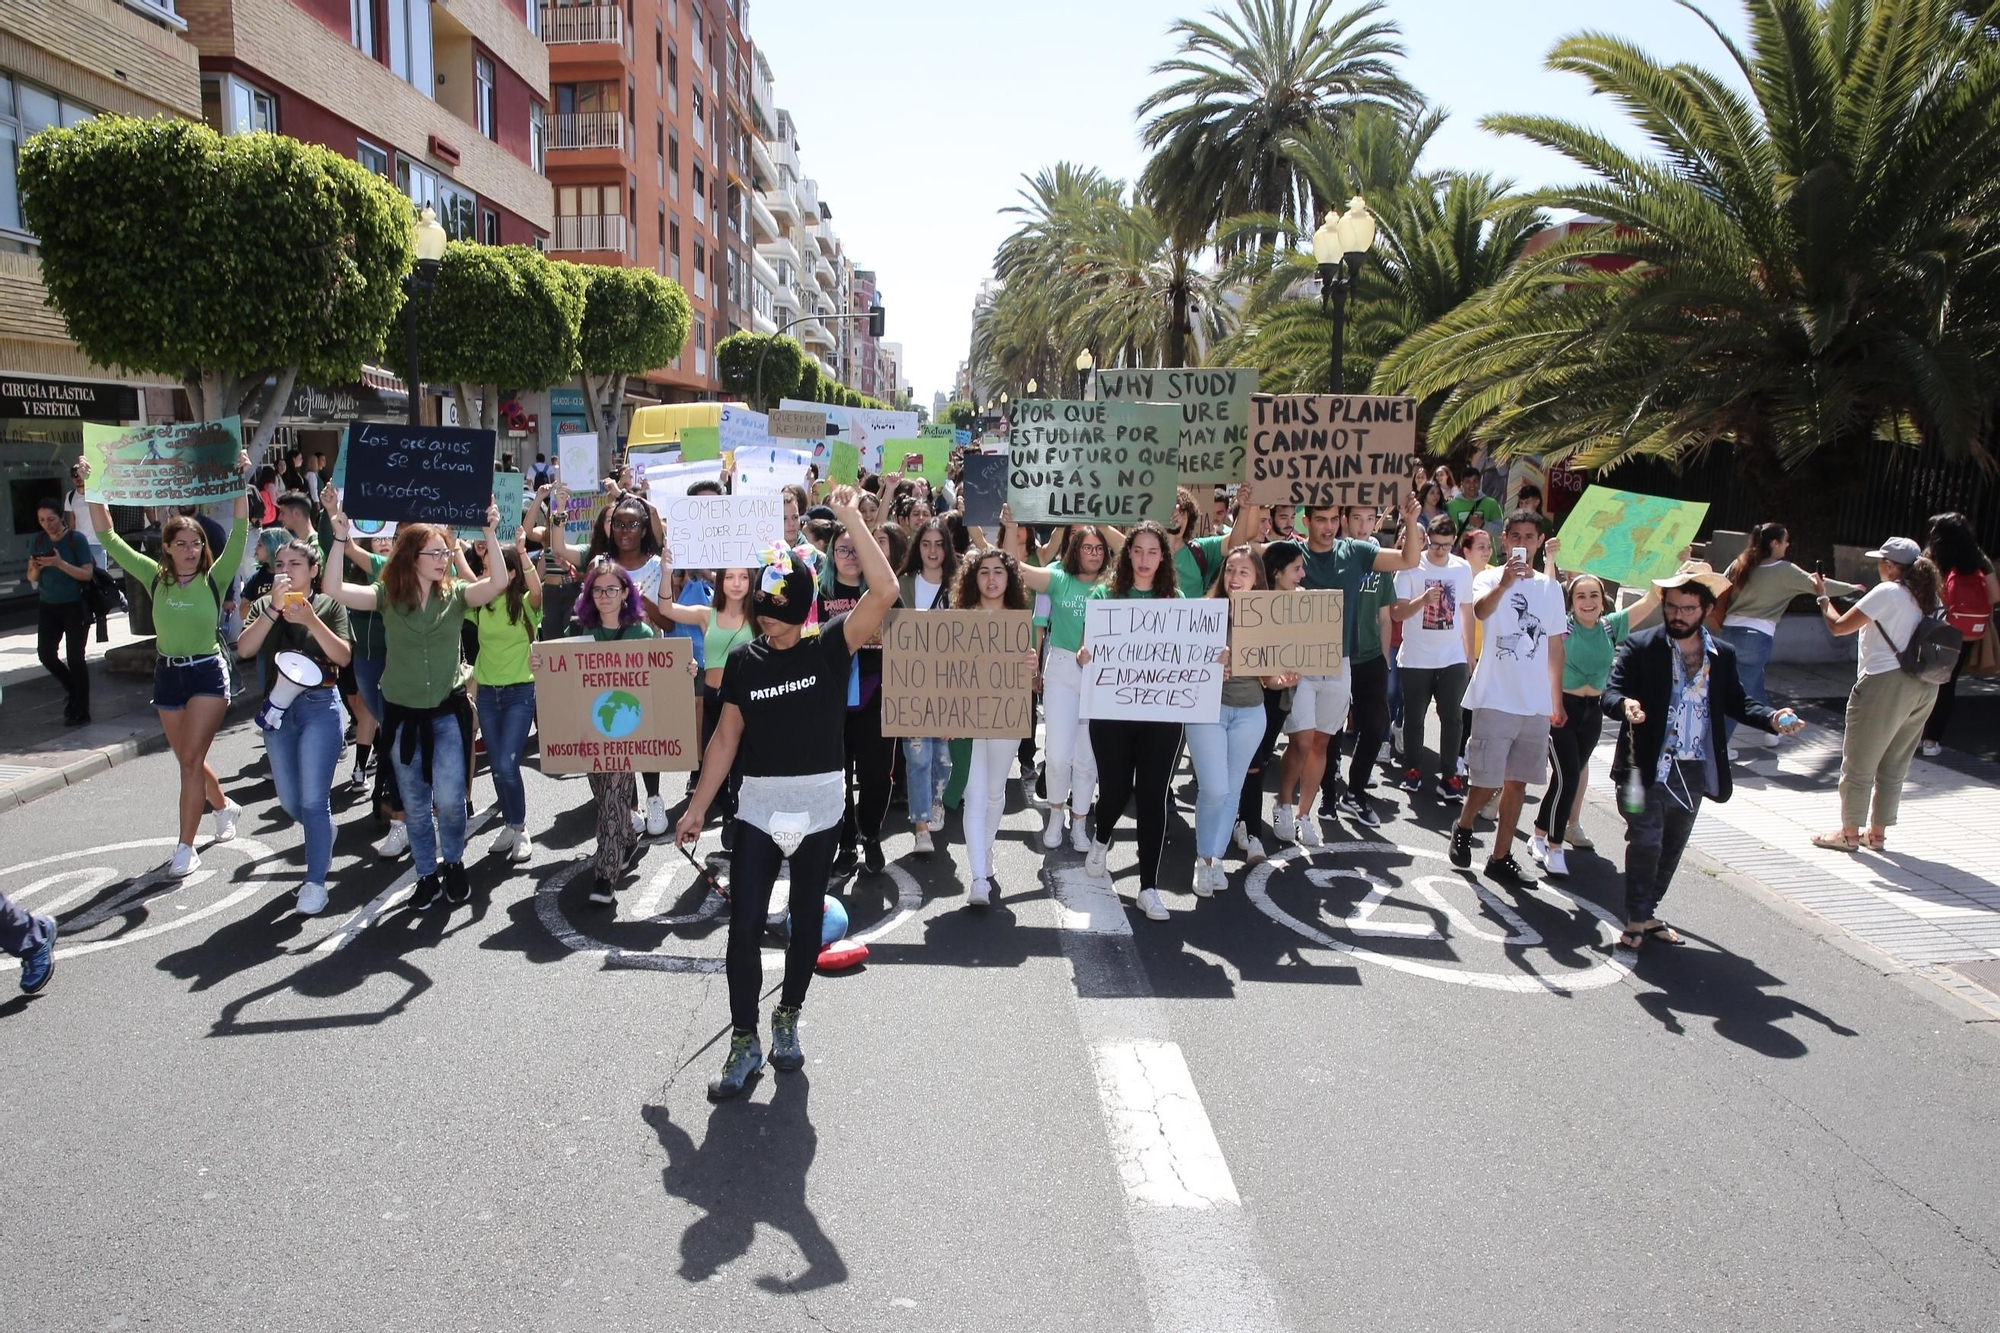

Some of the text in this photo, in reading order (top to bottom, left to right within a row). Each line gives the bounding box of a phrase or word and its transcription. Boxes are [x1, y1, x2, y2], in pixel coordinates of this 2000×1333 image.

[1, 382, 95, 401] CIRUGÍA PLÁSTICA
[1100, 371, 1237, 399] WHY STUDY
[22, 401, 81, 416] Y ESTÉTICA
[1010, 400, 1108, 426] ¿POR QUÉ
[1183, 400, 1229, 424] URE
[1251, 396, 1417, 426] THIS PLANET
[1009, 425, 1159, 447] ESTUDIAR POR
[1179, 424, 1248, 448] MAY NO
[1254, 428, 1370, 456] CANNOT
[1012, 447, 1179, 468] UN FUTURO QUE
[1254, 453, 1415, 481] SUSTAIN THIS
[1010, 465, 1155, 489] QUIZÁS NO
[1289, 481, 1399, 506] SYSTEM
[670, 499, 781, 522] COMER CARNE
[1049, 493, 1153, 522] LLEGUE?
[672, 523, 752, 542] ES JODER EL
[755, 520, 774, 534] GO
[670, 542, 757, 564] PLANETA
[1093, 607, 1224, 638] I DON'T WANT
[1232, 597, 1263, 628] LES
[888, 621, 1031, 653] IGNORARLO
[549, 651, 673, 672] LA TIERRA NO NOS
[1092, 642, 1224, 665] MY CHILDREN TO BE
[1239, 643, 1342, 669] SONT CUITES
[582, 671, 650, 688] PERTENECE
[890, 655, 1027, 690] NO HARÁ QUE
[1096, 667, 1211, 686] ENDANGERED
[750, 675, 817, 701] PATAFÍSICO
[884, 696, 1031, 729] DESAPAREZCA
[547, 739, 682, 757] NOSOTRES PERTENECEMOS
[593, 756, 631, 771] A ELLA
[774, 831, 802, 843] STOP
[1304, 868, 1543, 945] 20
